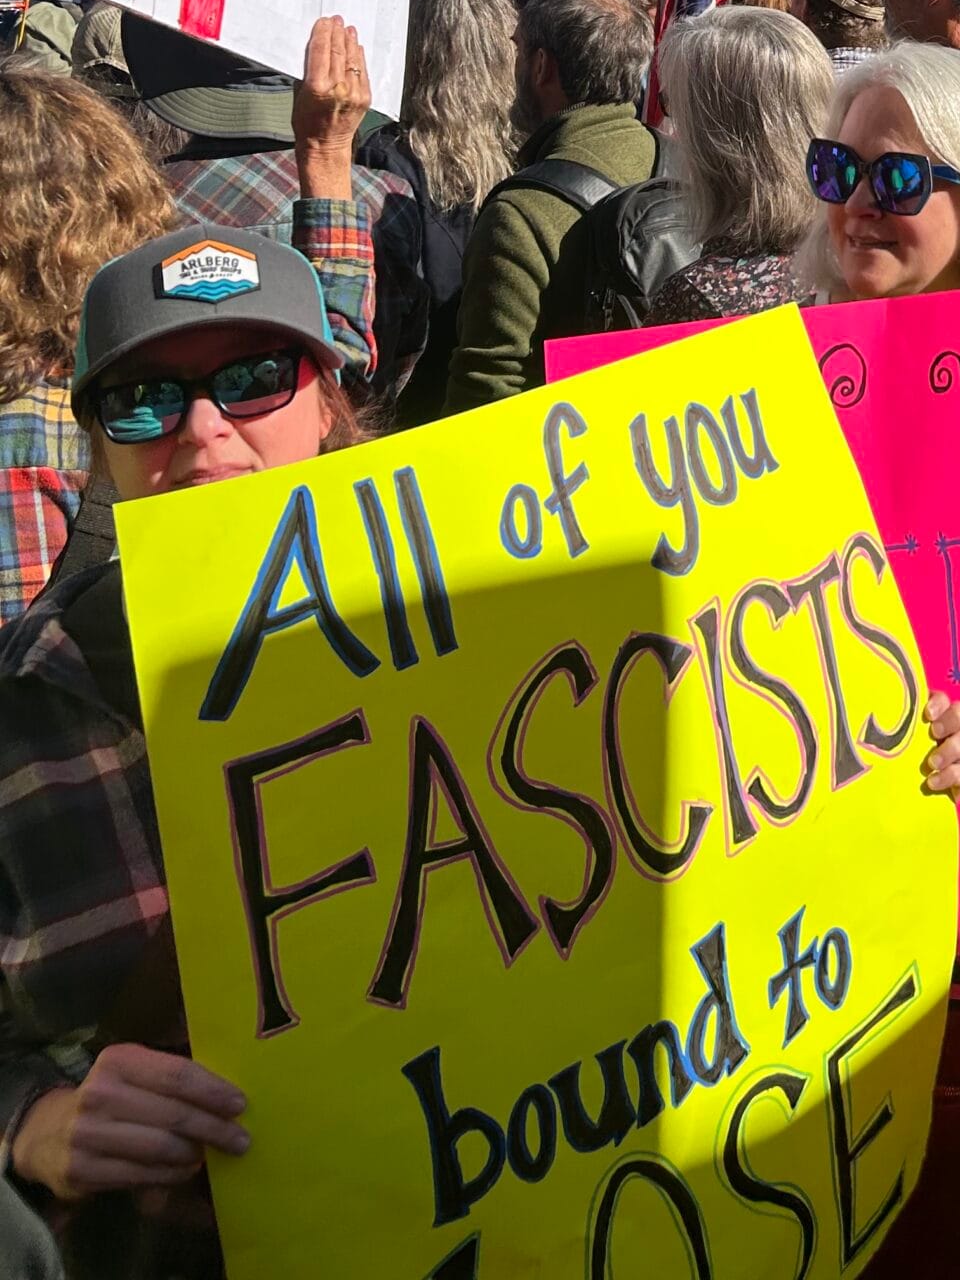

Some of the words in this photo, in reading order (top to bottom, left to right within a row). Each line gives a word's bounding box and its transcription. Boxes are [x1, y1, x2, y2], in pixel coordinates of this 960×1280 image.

[181, 255, 239, 273] ARLBERG
[198, 463, 458, 723] All
[499, 400, 590, 560] of
[629, 386, 779, 577] you
[223, 530, 921, 1040] FASCISTS
[401, 919, 751, 1229] bound
[766, 902, 853, 1048] to
